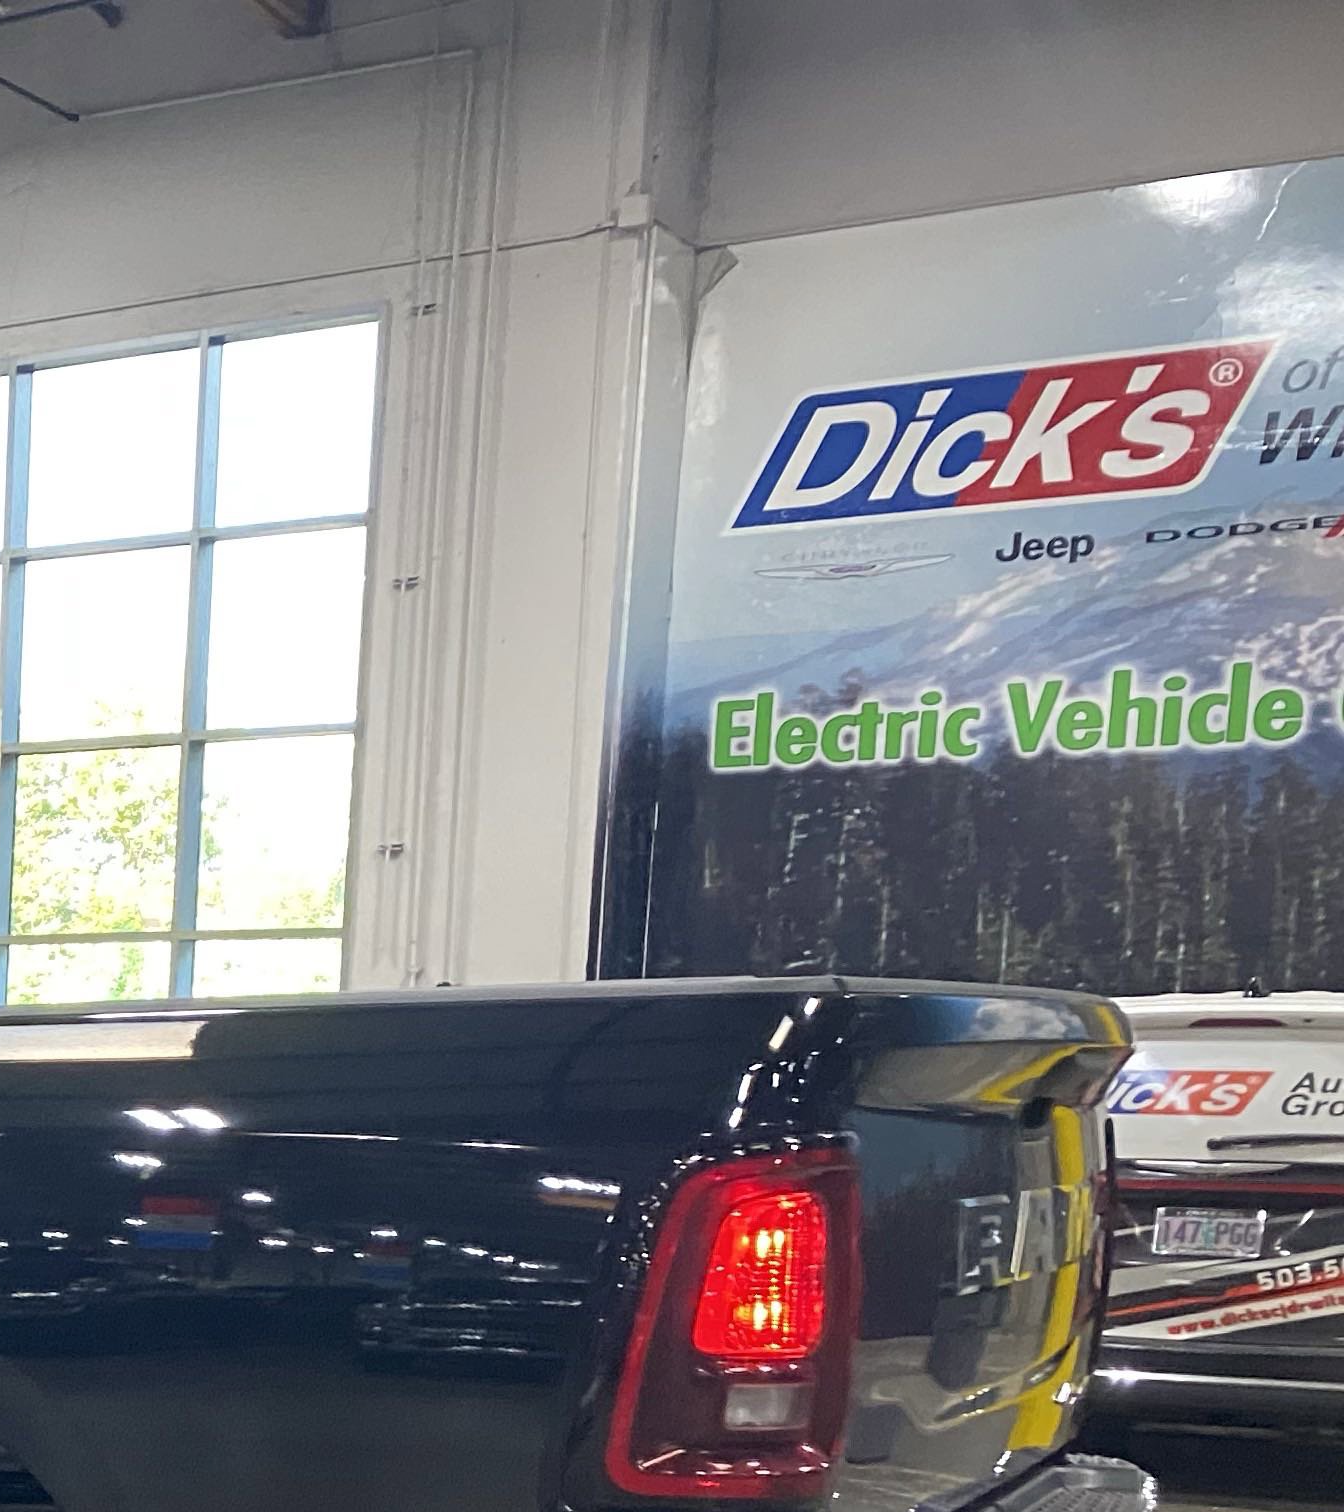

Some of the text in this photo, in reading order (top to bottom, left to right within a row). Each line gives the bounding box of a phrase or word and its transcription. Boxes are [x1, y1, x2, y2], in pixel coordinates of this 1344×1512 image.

[995, 531, 1096, 562] Jeep
[1144, 515, 1342, 545] DODGE
[712, 662, 1304, 768] Electric Vehicle
[1105, 1073, 1249, 1112] ick's
